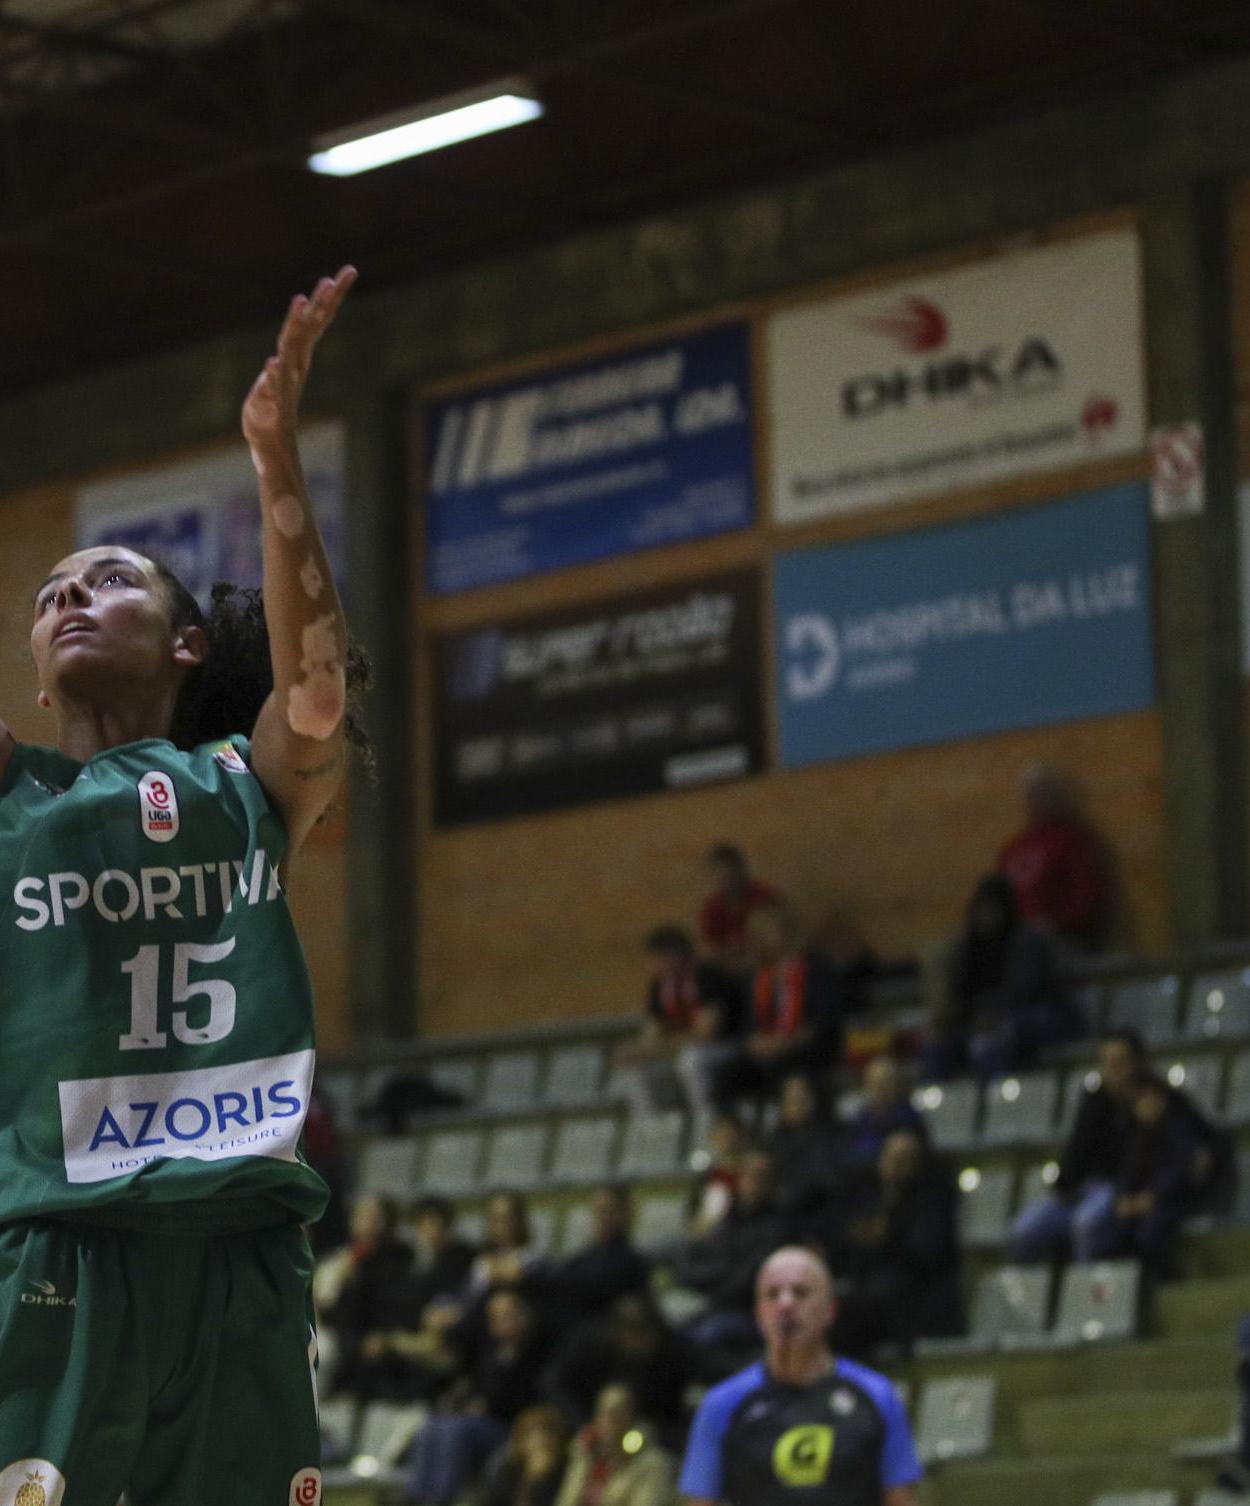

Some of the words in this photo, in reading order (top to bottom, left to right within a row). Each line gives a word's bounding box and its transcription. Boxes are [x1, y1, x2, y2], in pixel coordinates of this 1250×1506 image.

[841, 334, 1062, 421] DHIKA
[845, 589, 1008, 652] HOSPITAL
[1009, 581, 1066, 629] DA
[1068, 564, 1141, 618] LUZ
[119, 936, 237, 1051] 15
[89, 1080, 301, 1151] AZORIS
